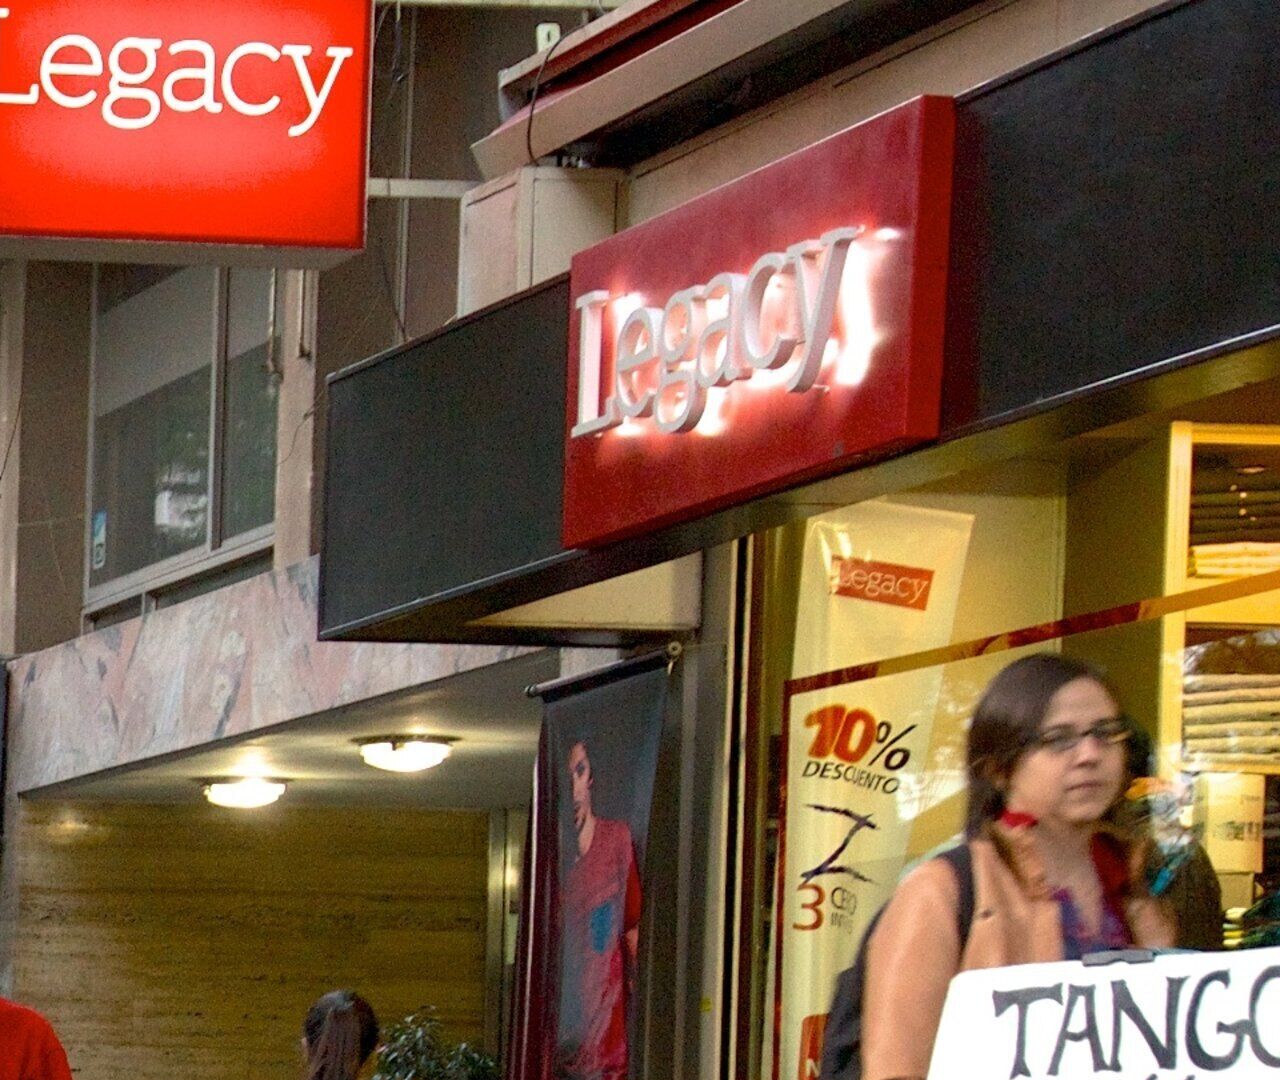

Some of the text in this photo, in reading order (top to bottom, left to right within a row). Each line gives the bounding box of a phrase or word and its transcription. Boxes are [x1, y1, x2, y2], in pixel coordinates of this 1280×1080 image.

[571, 227, 860, 438] Legacy
[804, 703, 917, 770] 10%
[802, 760, 900, 794] DESCUENTO
[792, 883, 826, 931] 3
